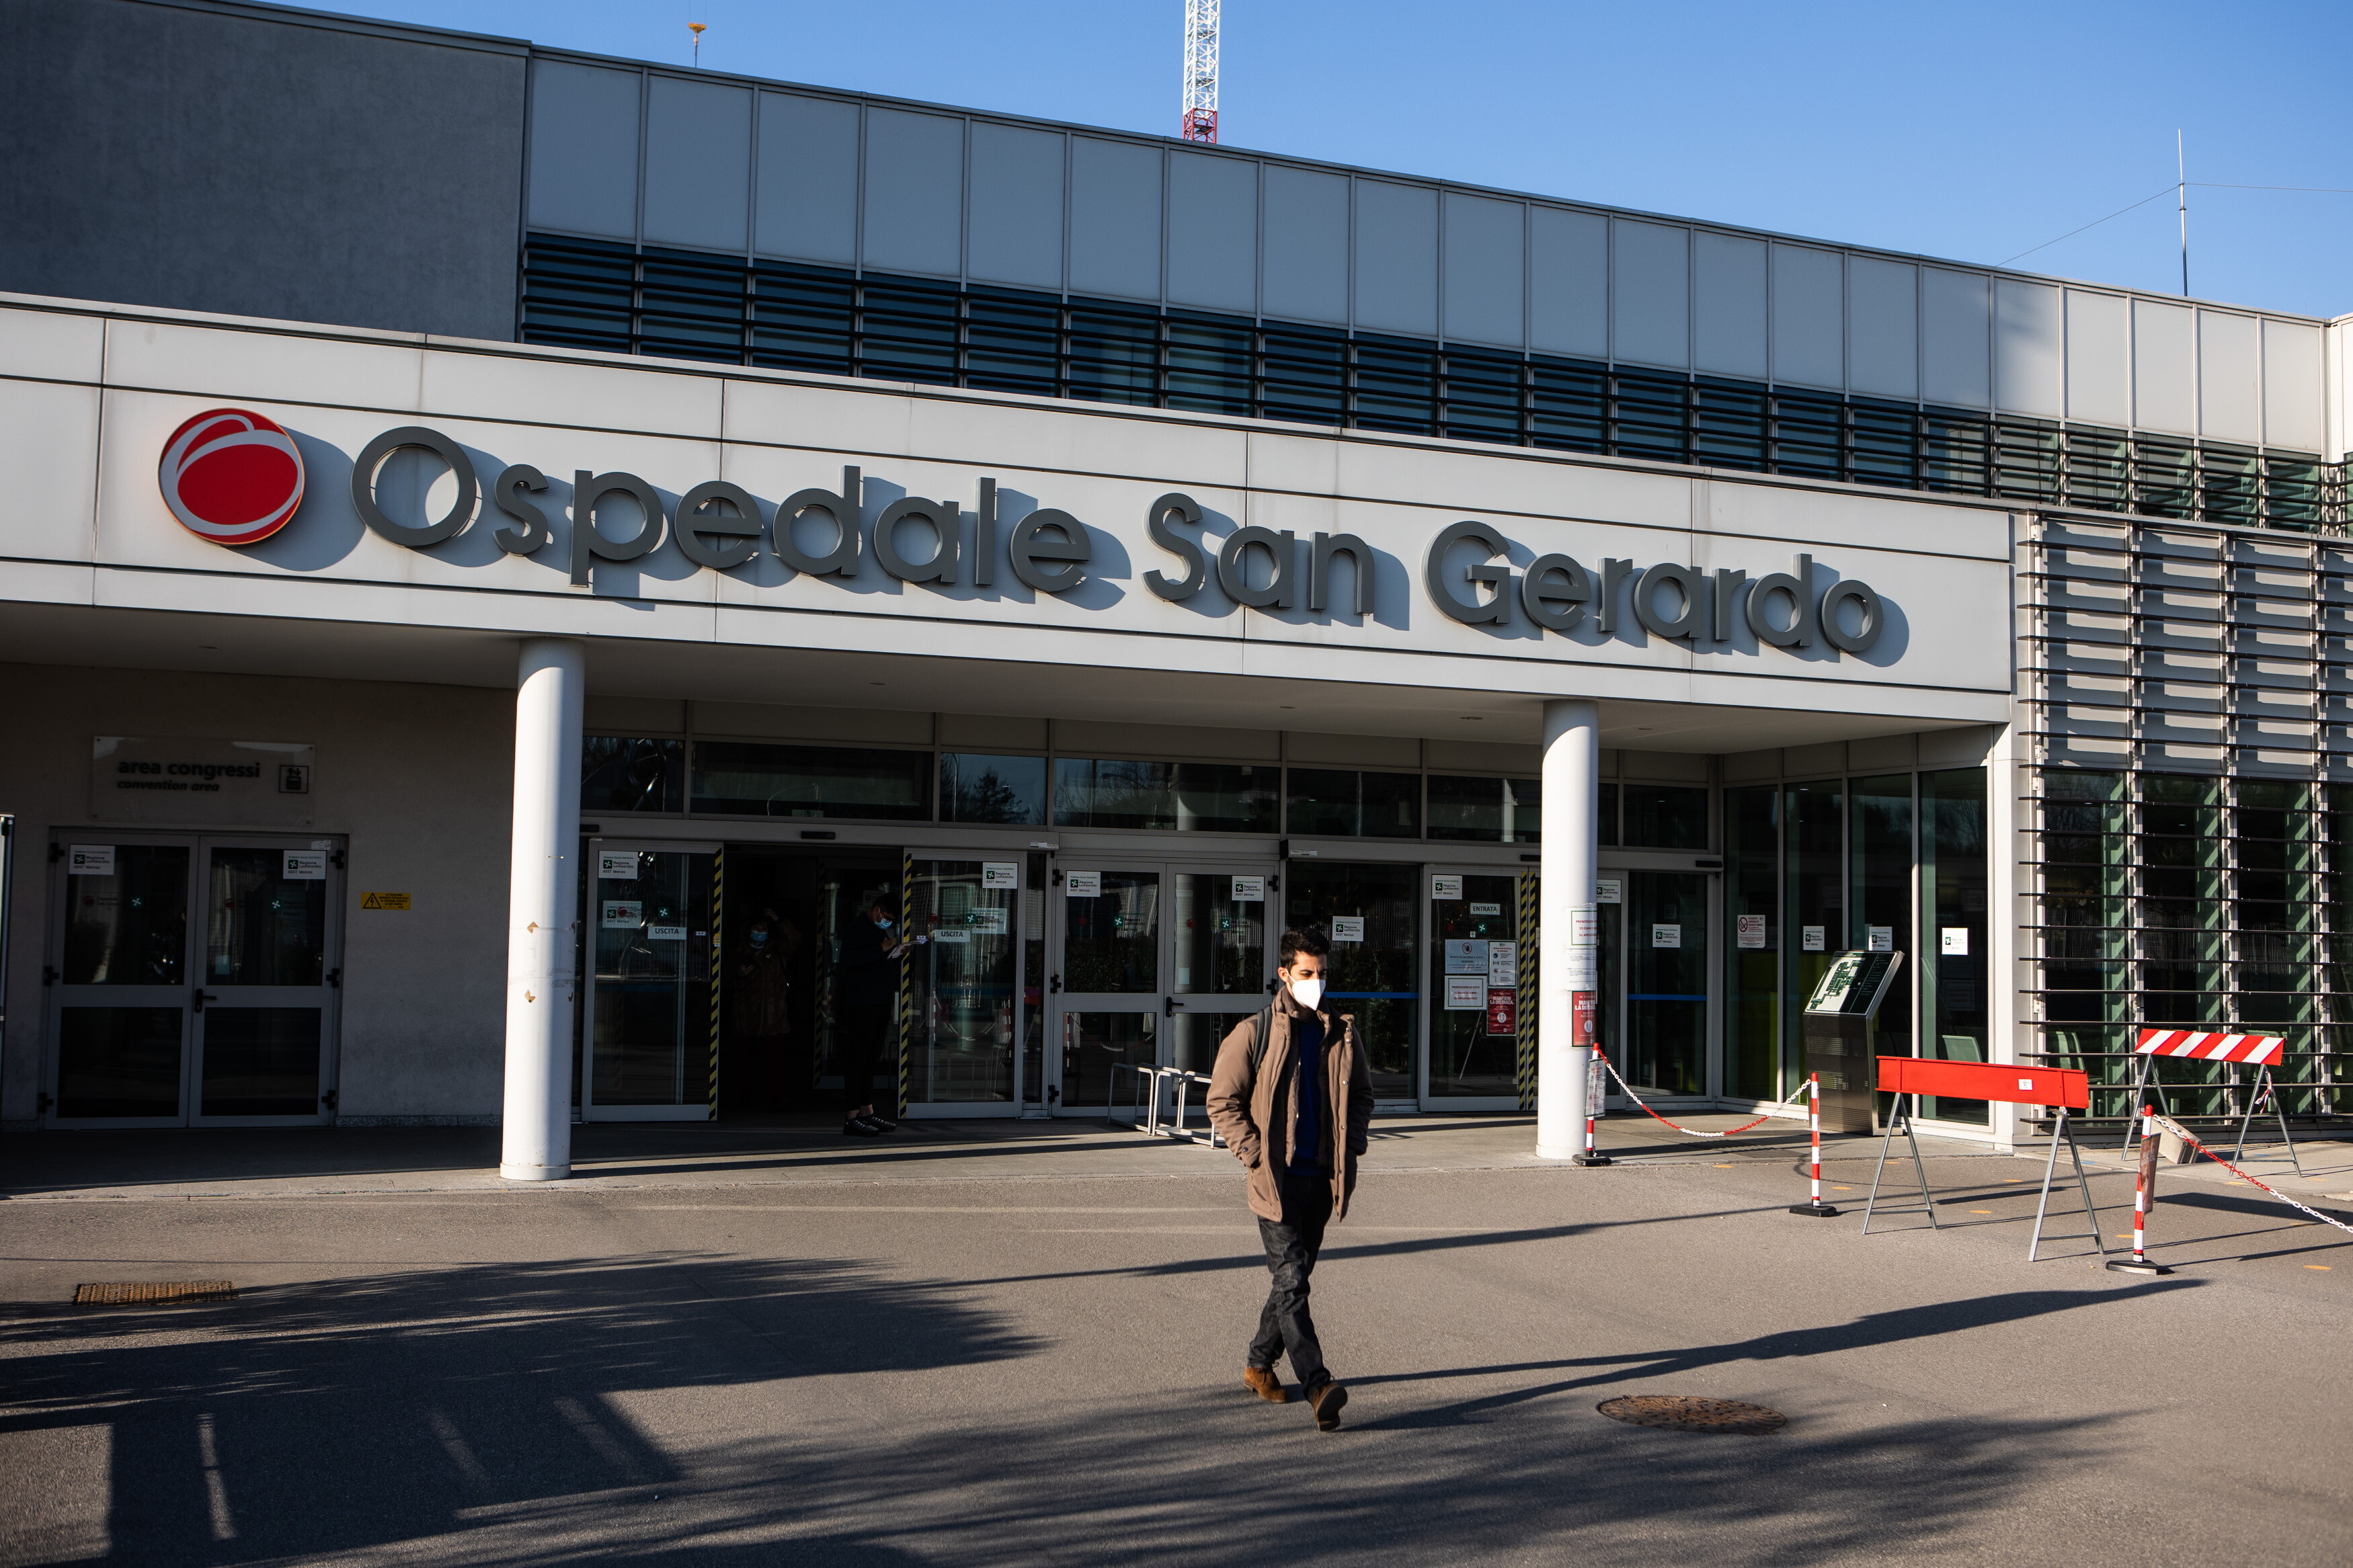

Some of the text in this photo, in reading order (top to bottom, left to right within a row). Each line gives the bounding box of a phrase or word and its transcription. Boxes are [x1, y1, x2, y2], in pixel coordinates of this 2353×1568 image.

[351, 425, 1883, 653] Ospedale San Gerardo
[118, 761, 260, 780] area congressi
[117, 780, 219, 791] convention area
